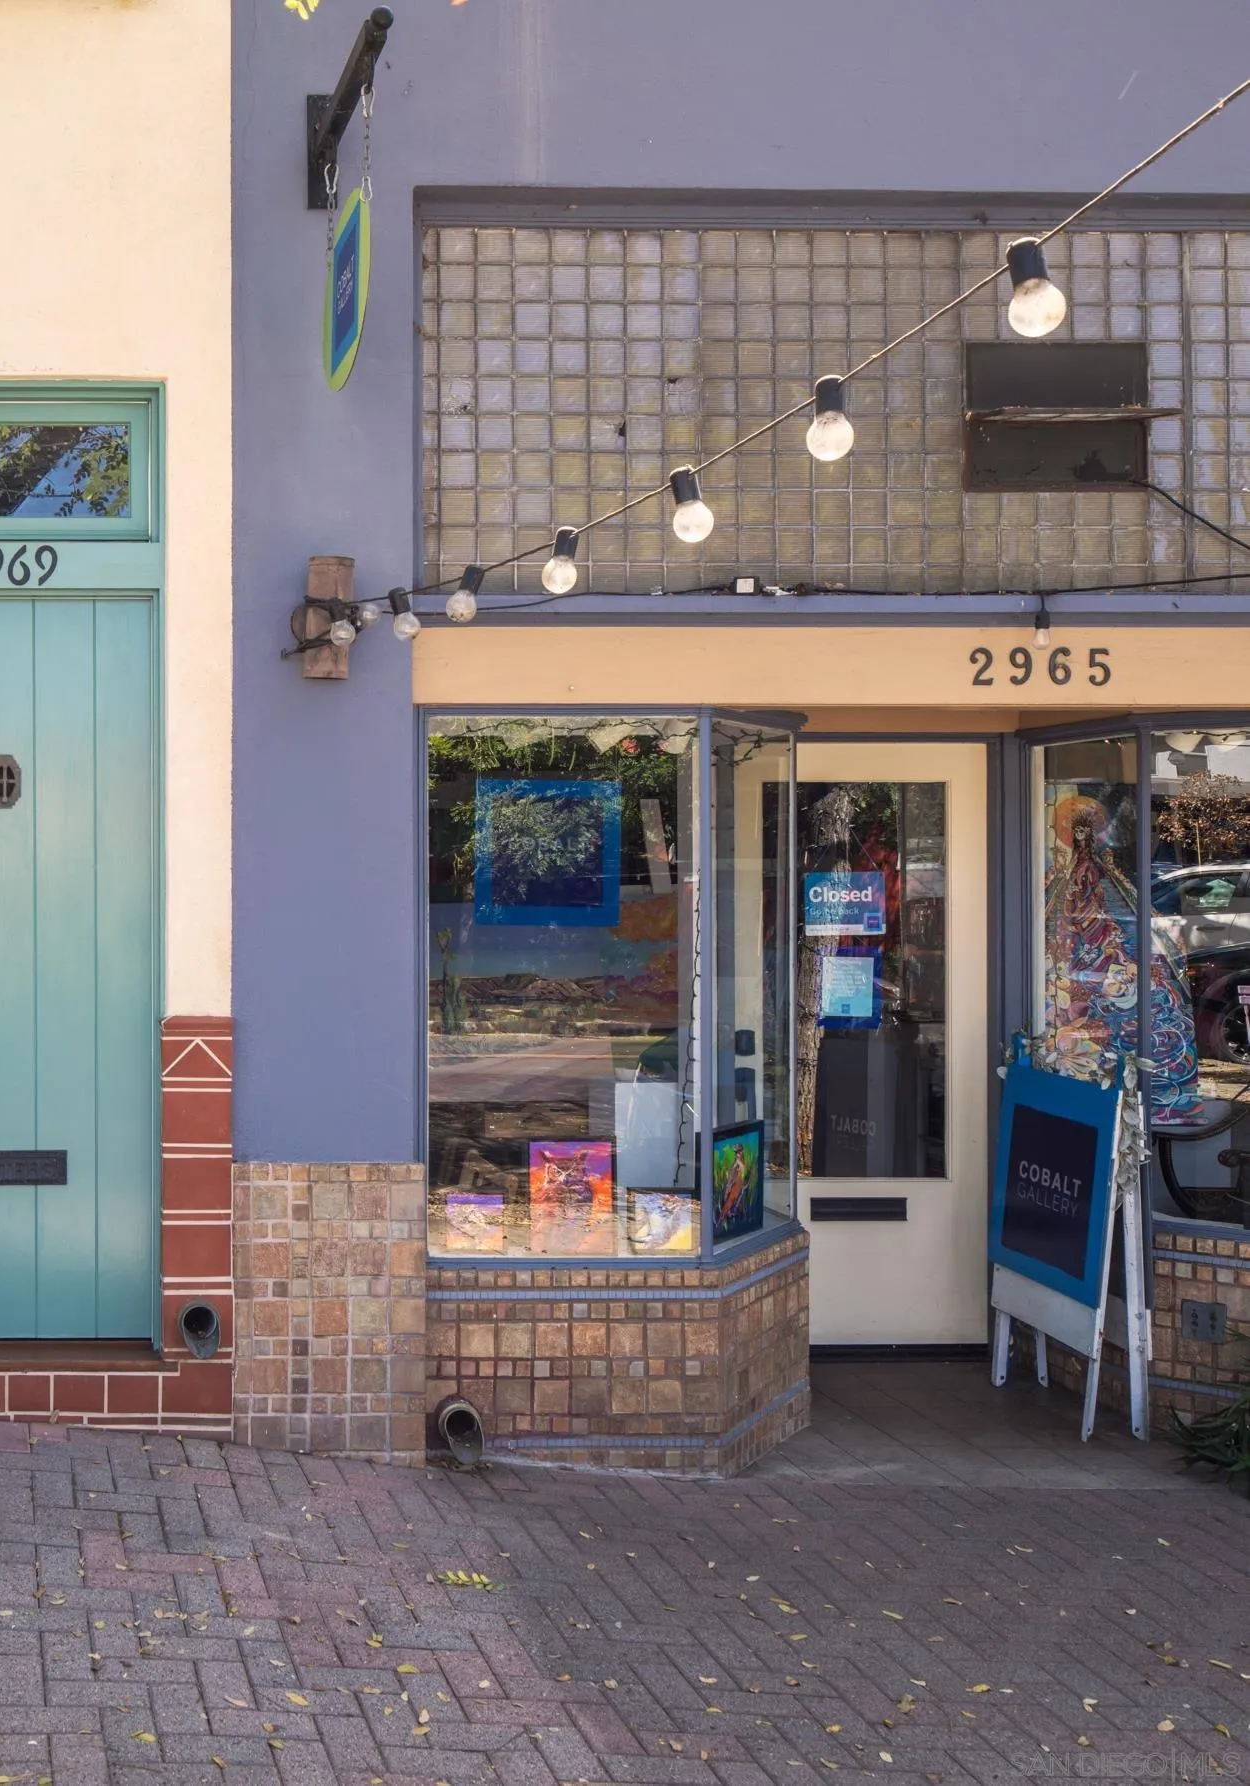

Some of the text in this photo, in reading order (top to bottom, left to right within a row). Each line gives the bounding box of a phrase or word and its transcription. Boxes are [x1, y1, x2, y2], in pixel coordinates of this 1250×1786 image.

[969, 646, 1111, 686] 2965
[808, 886, 873, 903] Closed
[1019, 1160, 1082, 1198] COBALT
[1017, 1181, 1079, 1218] GALLERY
